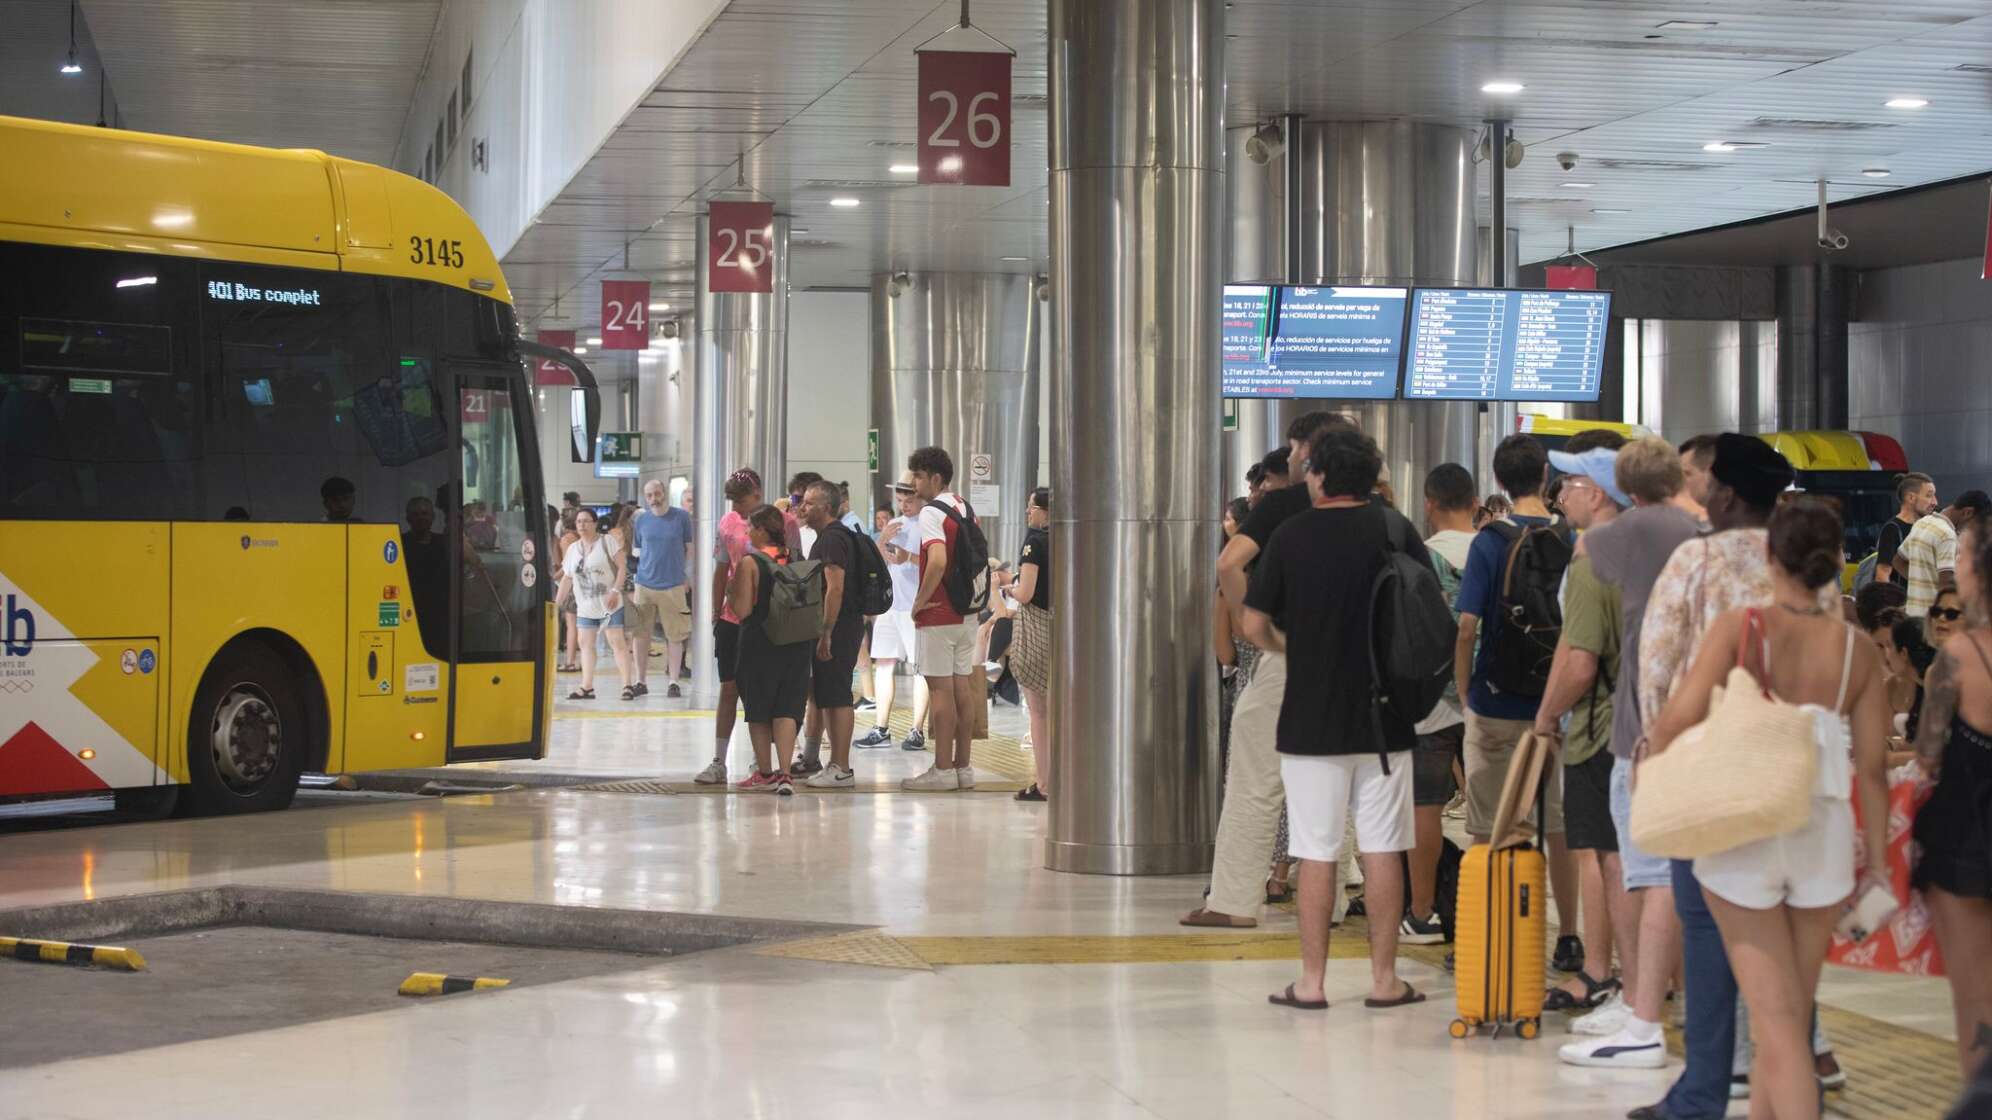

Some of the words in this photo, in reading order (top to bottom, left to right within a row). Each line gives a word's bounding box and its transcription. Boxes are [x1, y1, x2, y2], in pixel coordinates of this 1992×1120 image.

[927, 90, 1001, 148] 26
[409, 235, 464, 268] 3145
[716, 228, 767, 268] 25
[207, 280, 233, 300] 401
[235, 283, 261, 301] Bus
[264, 289, 320, 305] complet
[606, 300, 645, 331] 24
[465, 395, 486, 412] 21
[0, 594, 35, 656] b
